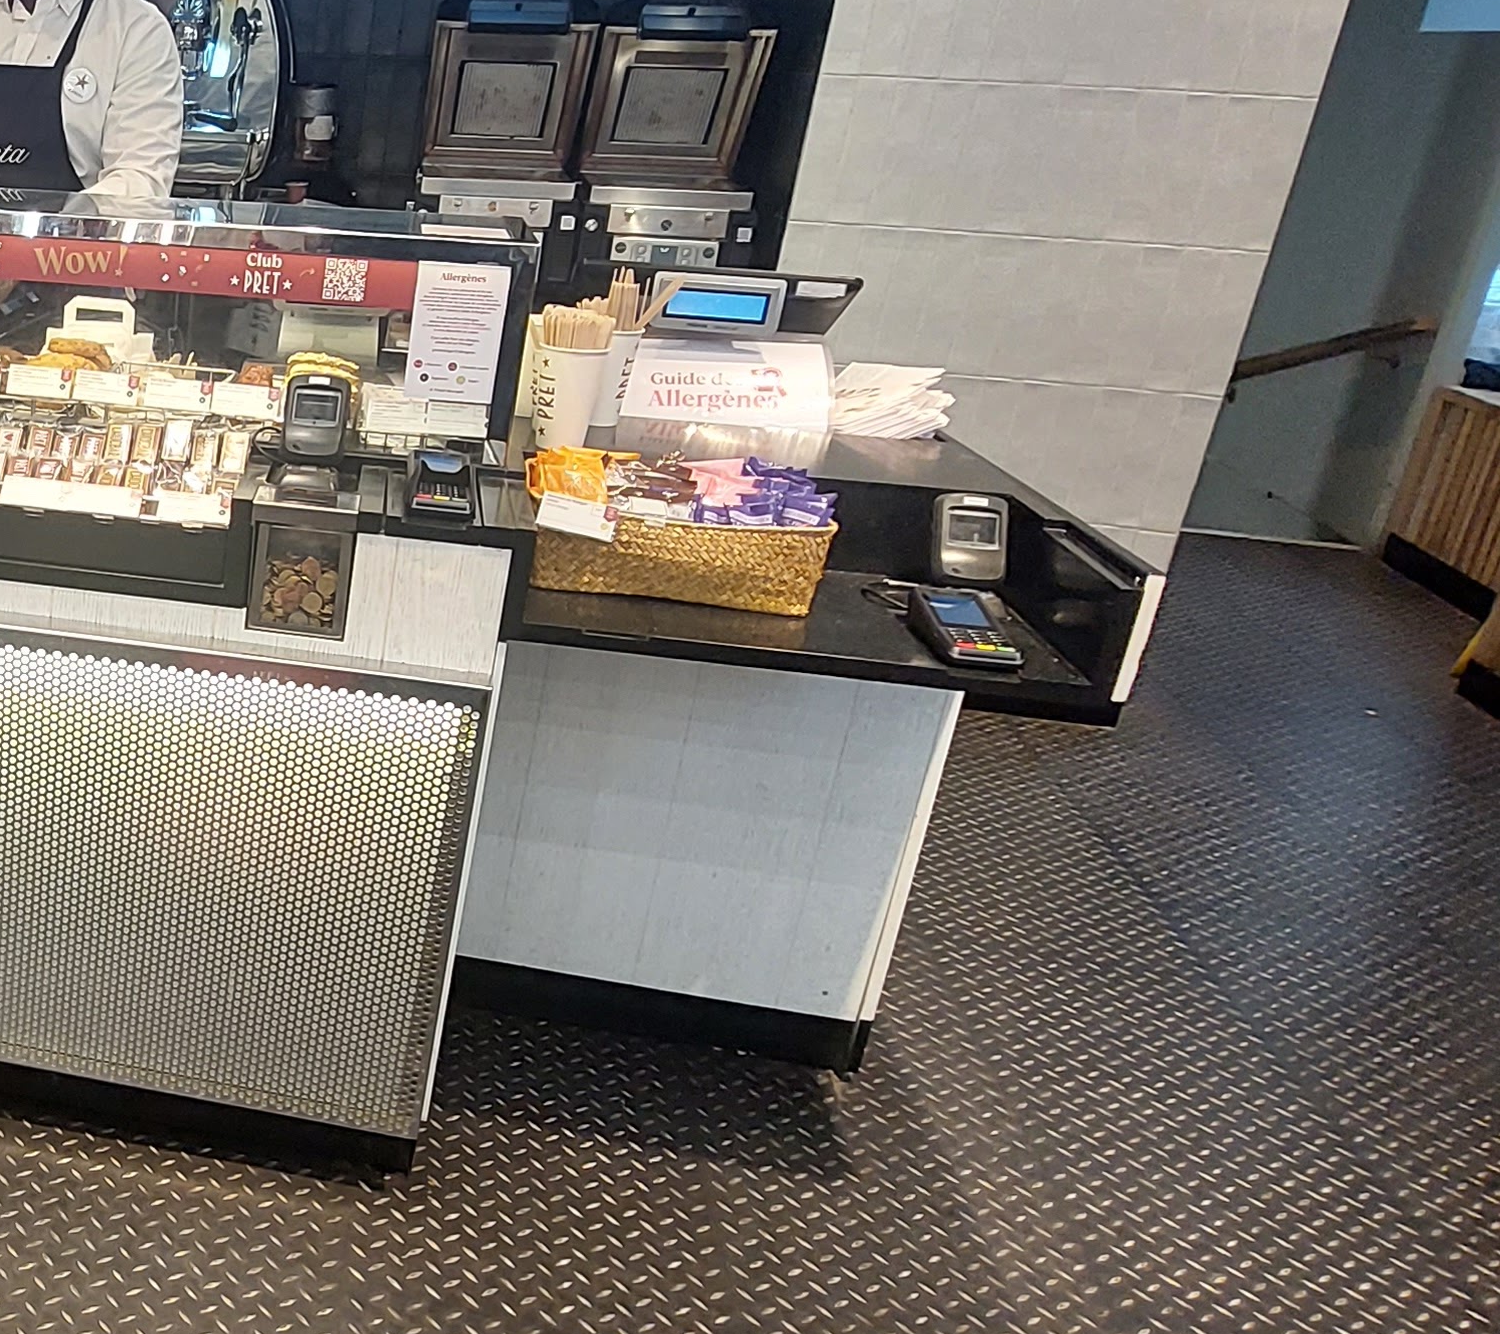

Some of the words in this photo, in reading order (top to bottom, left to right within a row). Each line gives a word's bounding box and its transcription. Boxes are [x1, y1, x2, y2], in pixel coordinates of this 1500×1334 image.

[246, 252, 283, 269] Club
[243, 269, 282, 295] PRET
[440, 272, 487, 284] Allergènes
[650, 371, 706, 386] Guide
[536, 374, 557, 421] PRET
[648, 388, 779, 413] Allergènes
